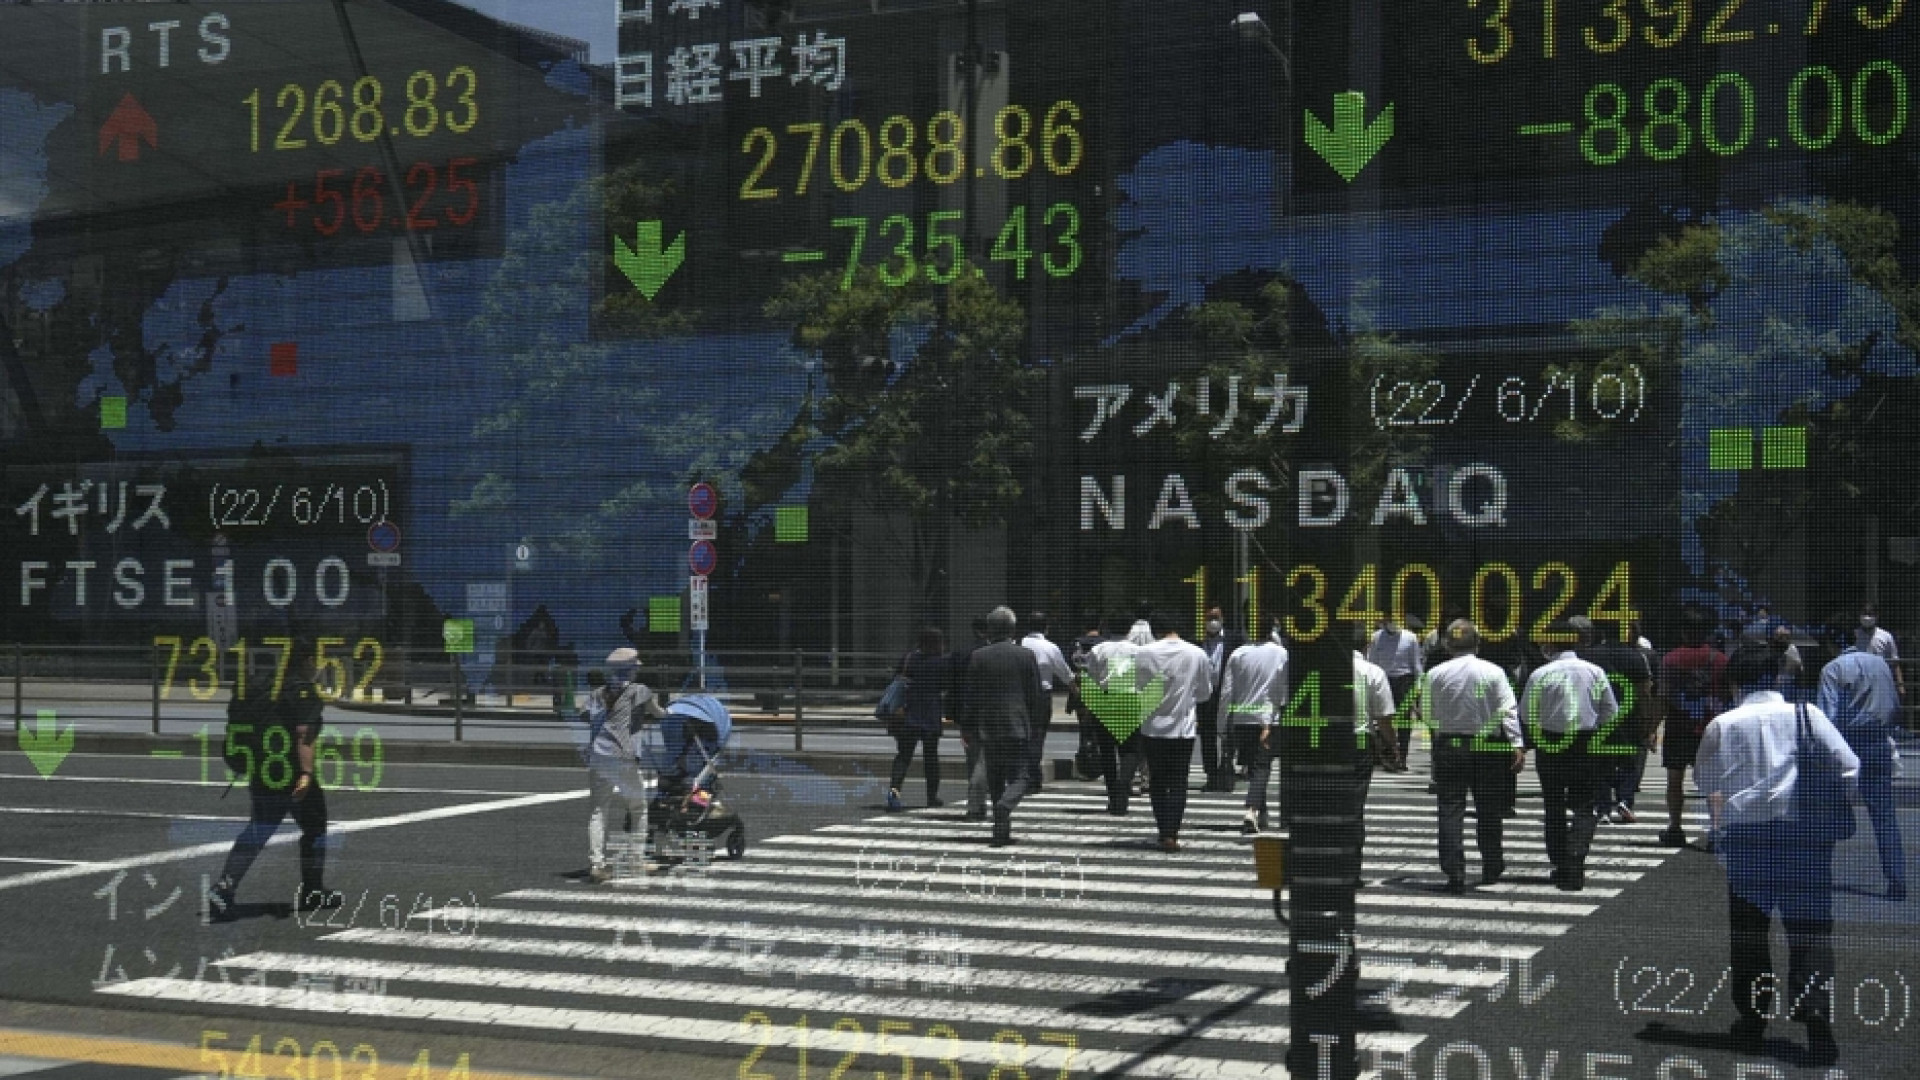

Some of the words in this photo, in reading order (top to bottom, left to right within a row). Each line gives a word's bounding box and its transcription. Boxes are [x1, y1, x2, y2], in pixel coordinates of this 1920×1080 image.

[101, 12, 231, 74] RTS
[614, 29, 846, 110] 日経平均
[242, 65, 479, 153] 1268.83
[1516, 59, 1907, 165] -880.00
[740, 100, 1083, 200] 27088.86
[273, 157, 480, 236] +56.25
[780, 203, 1083, 291] -735.43
[1074, 373, 1308, 442] アメリカ
[15, 479, 170, 536] イギリス
[1079, 461, 1509, 531] NASDAQ
[1182, 561, 1642, 644] 11340.024
[153, 635, 385, 703] 7317.52
[1227, 671, 1640, 755] -414.202
[150, 722, 385, 792] -158.69
[93, 870, 233, 926] インド
